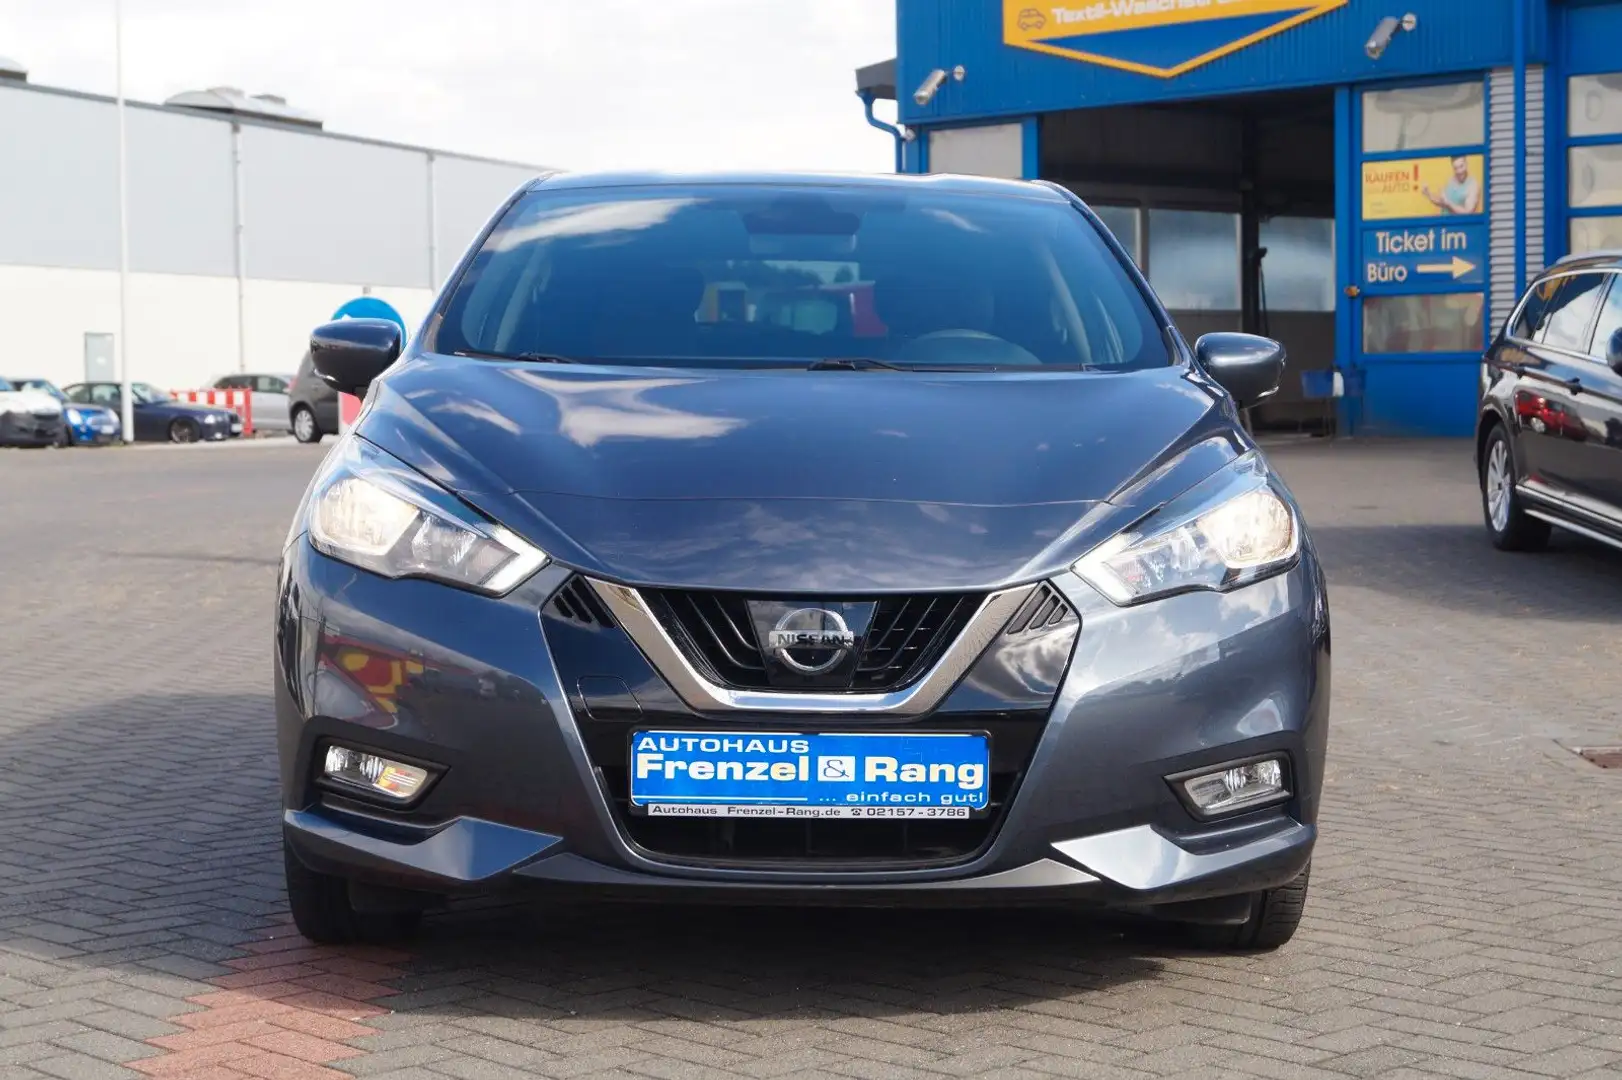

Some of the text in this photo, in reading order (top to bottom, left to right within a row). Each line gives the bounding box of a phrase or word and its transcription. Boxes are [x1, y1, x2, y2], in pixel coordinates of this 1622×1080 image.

[1376, 228, 1467, 254] Ticket im
[1367, 261, 1408, 283] Büro
[777, 633, 845, 645] NISSAN
[637, 737, 809, 753] AUTOHAUS
[636, 753, 984, 790] Frenzel & Rang
[846, 791, 931, 803] einfach
[940, 792, 984, 805] gut!
[652, 805, 718, 815] Autohaus
[727, 806, 841, 817] Frenzel-Rang.de
